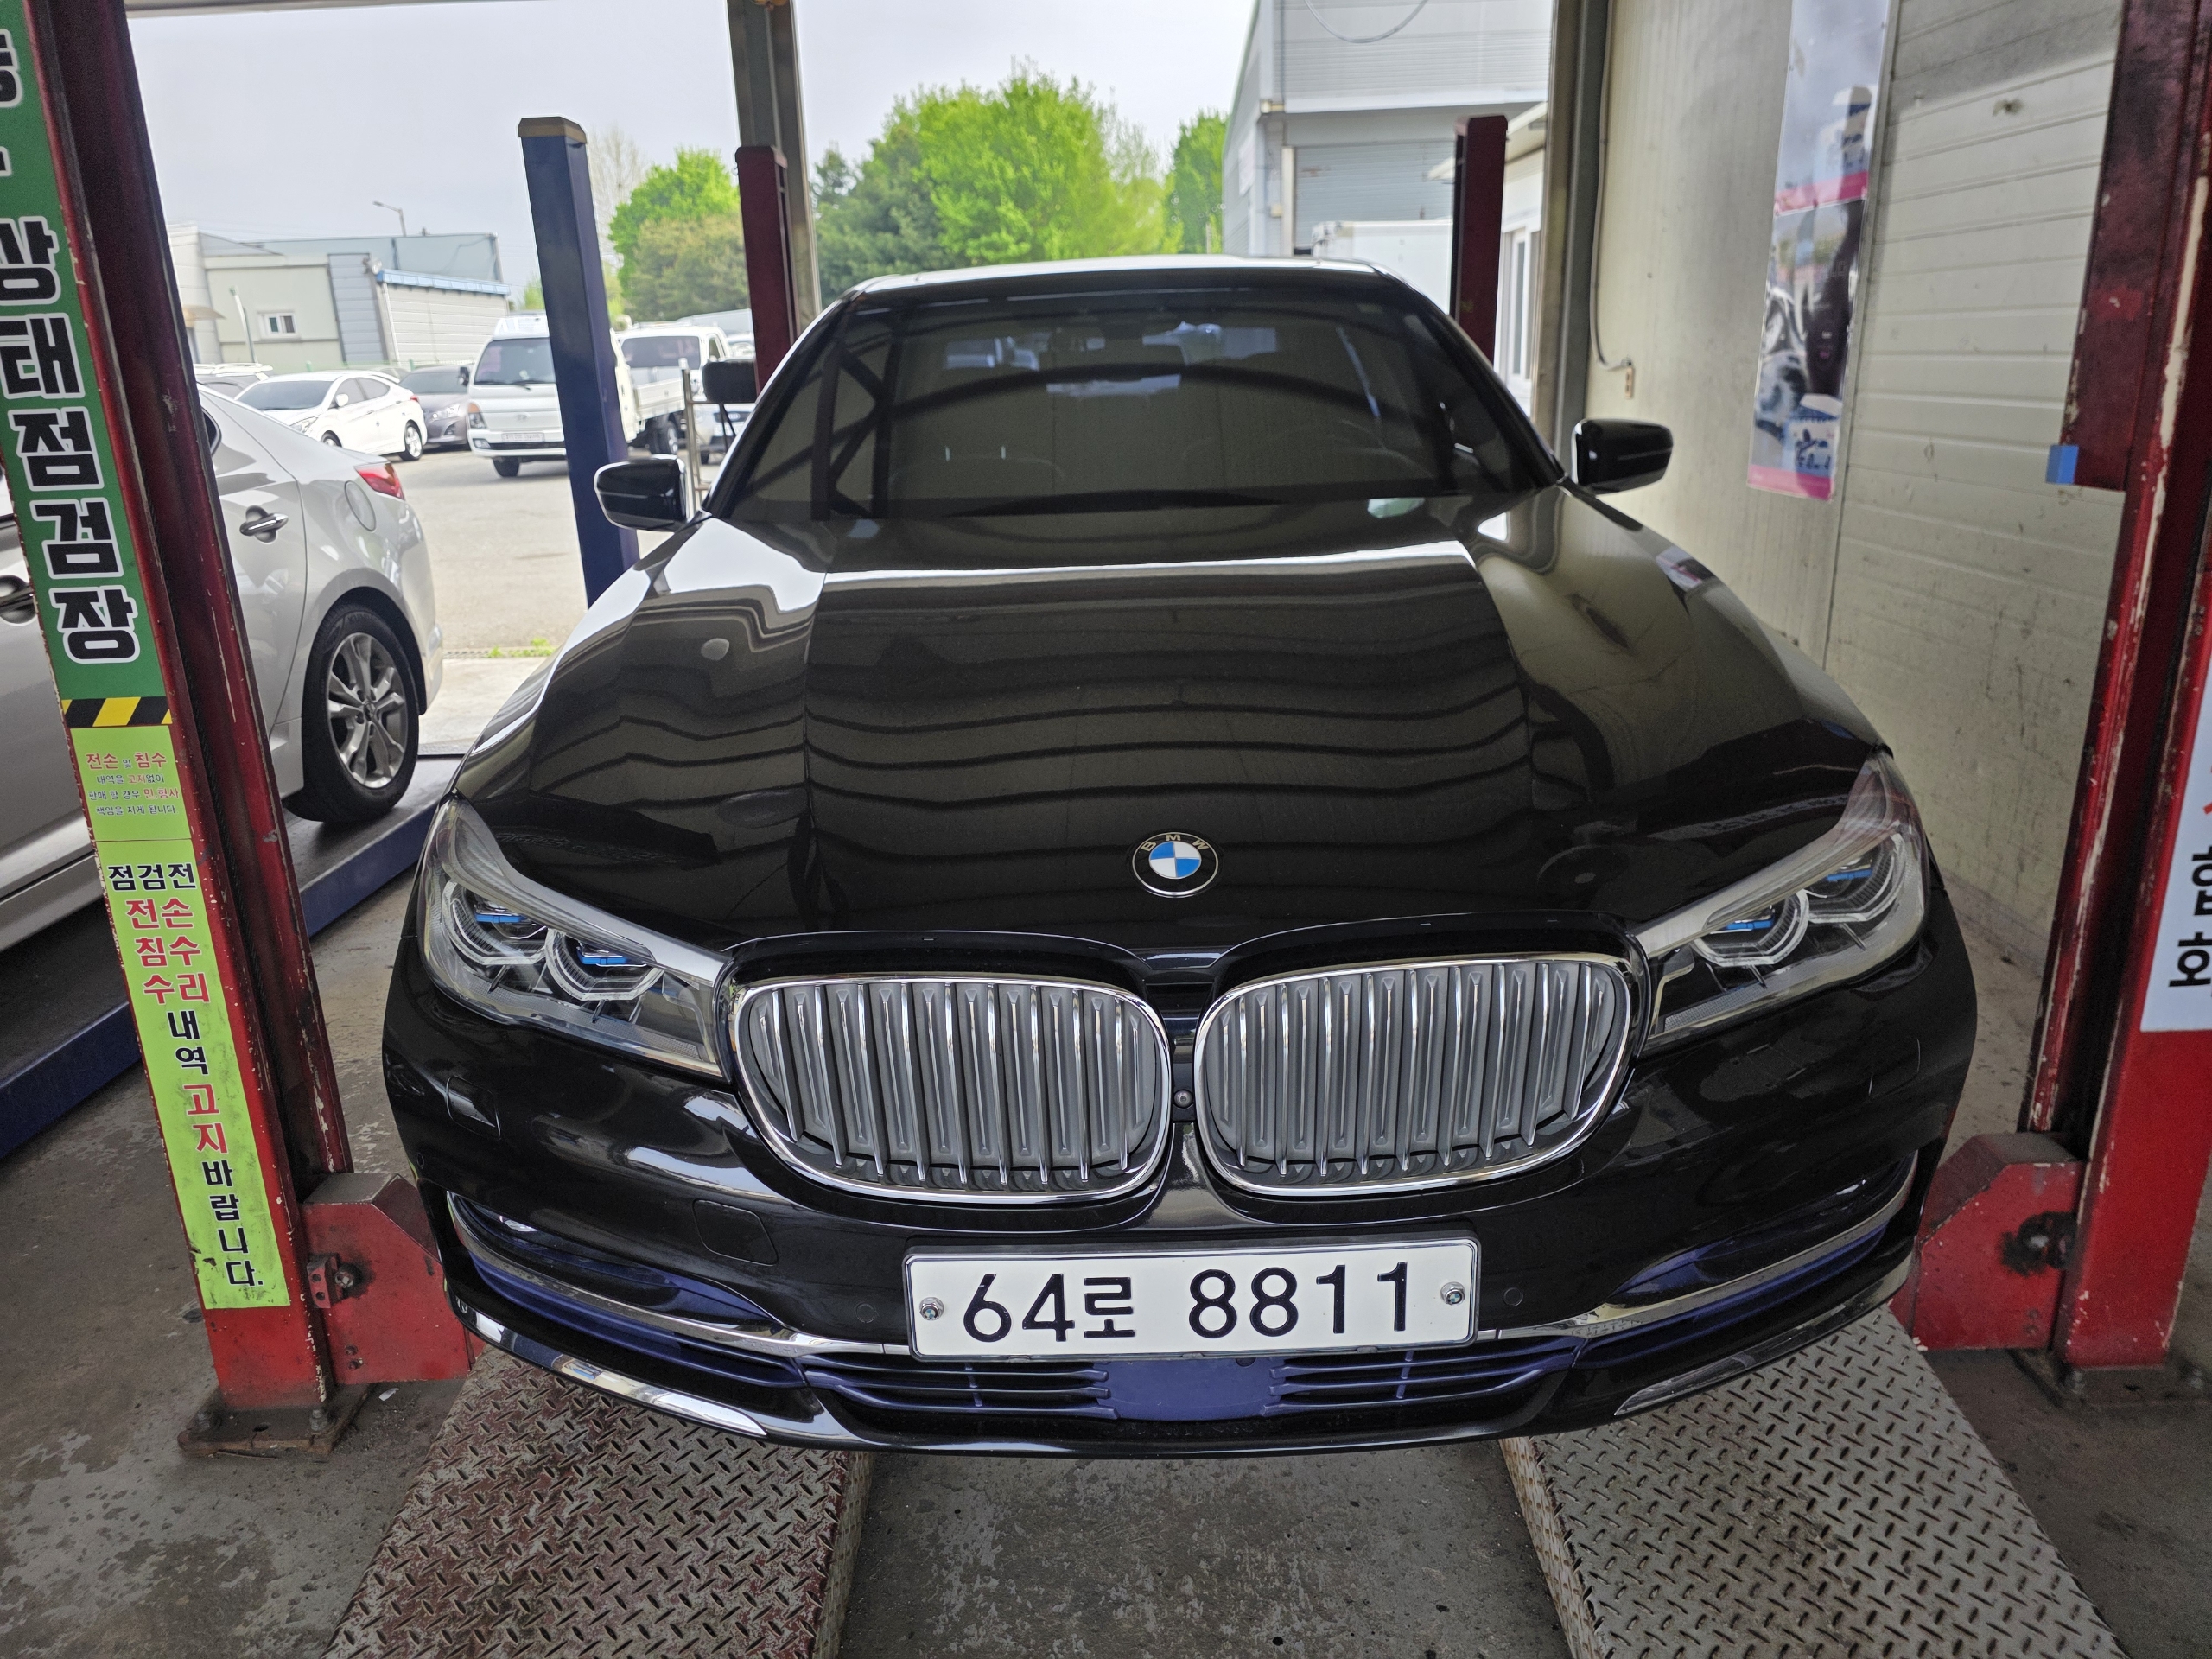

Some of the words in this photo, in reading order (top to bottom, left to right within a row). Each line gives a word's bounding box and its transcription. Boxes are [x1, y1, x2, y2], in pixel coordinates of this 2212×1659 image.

[86, 753, 119, 770] 전손
[123, 759, 131, 769] 및
[134, 752, 167, 769] 침수
[97, 774, 124, 785] 내역을
[128, 773, 164, 784] 고지없이
[123, 790, 140, 800] 경우
[96, 806, 124, 816] 책임을
[127, 805, 145, 815] 지게
[1141, 834, 1210, 852] BMW
[107, 862, 197, 892] 점검전
[125, 896, 194, 931] 전손
[135, 935, 201, 968] 침수
[143, 972, 211, 1006] 수리
[166, 1009, 209, 1076] 내역
[963, 1272, 1137, 1344] 64로
[1188, 1260, 1409, 1338] 8811
